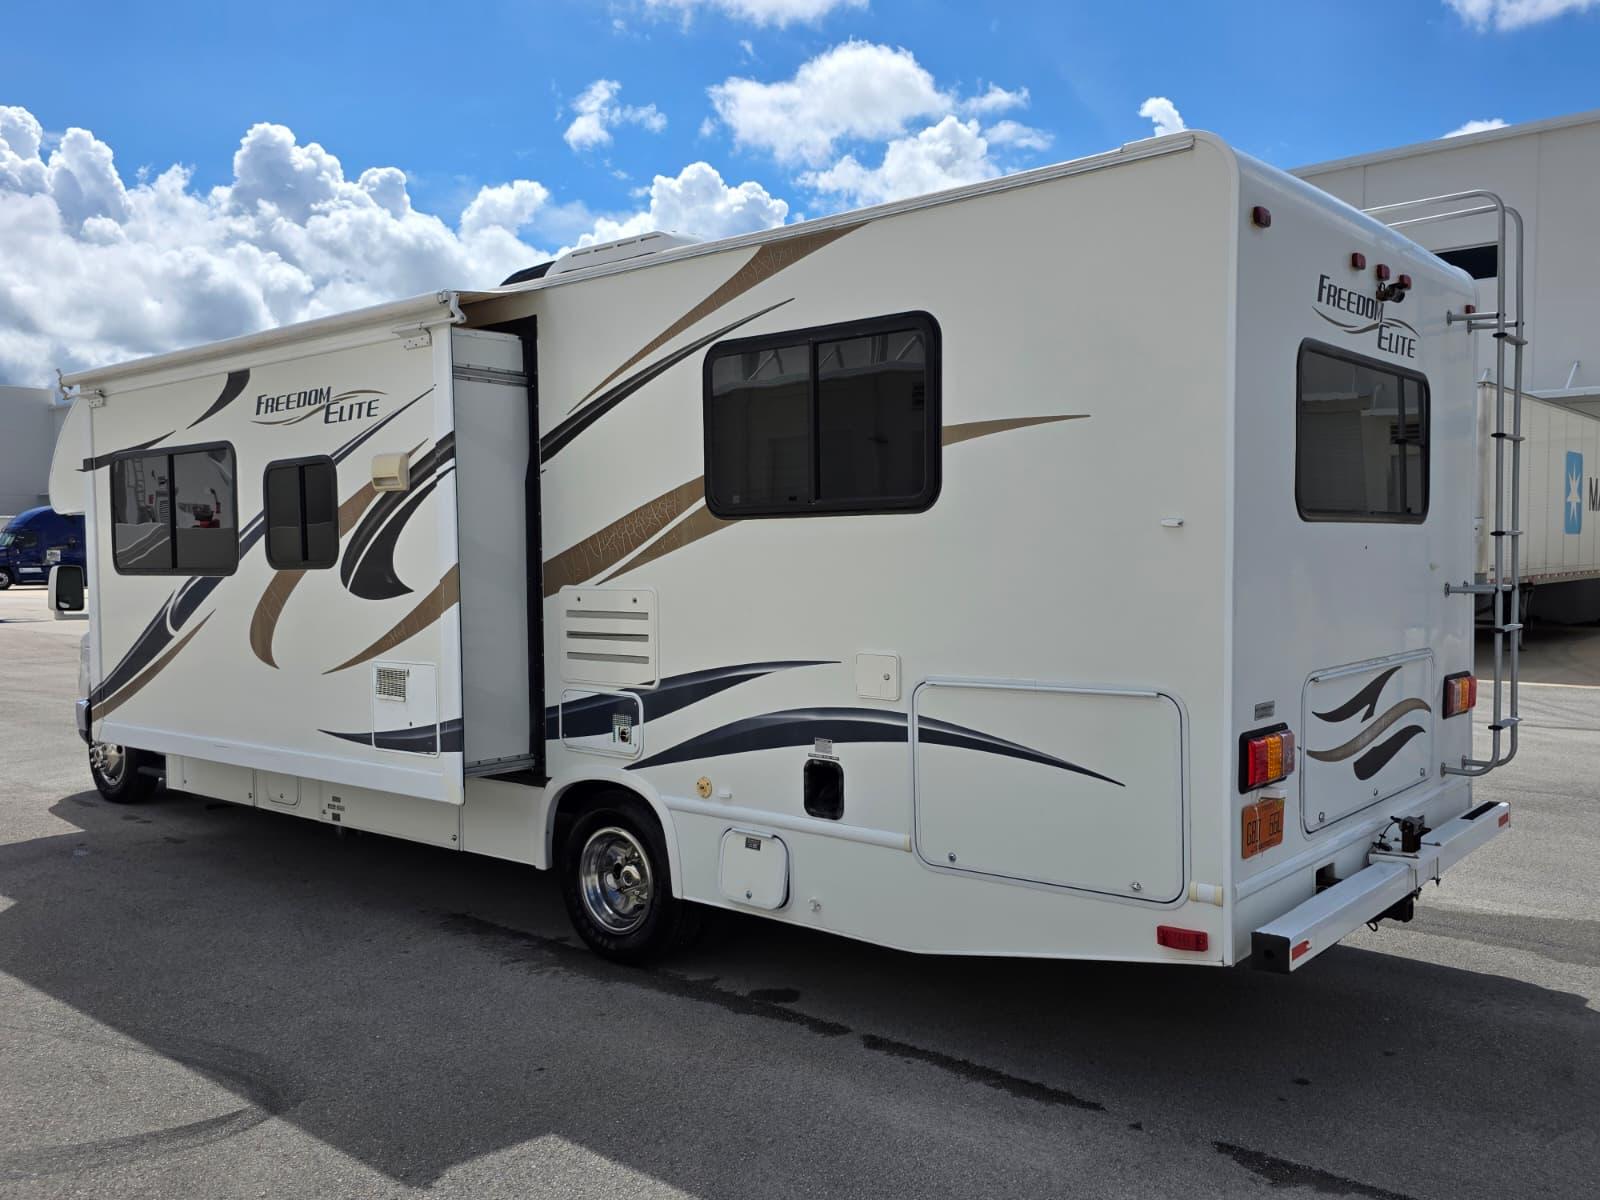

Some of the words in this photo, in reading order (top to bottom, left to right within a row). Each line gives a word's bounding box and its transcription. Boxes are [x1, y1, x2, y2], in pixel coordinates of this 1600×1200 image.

[1317, 274, 1384, 323] FREEDOM
[1377, 324, 1416, 359] ELITE
[256, 386, 331, 416] FREEDOM
[324, 399, 380, 424] ELITE
